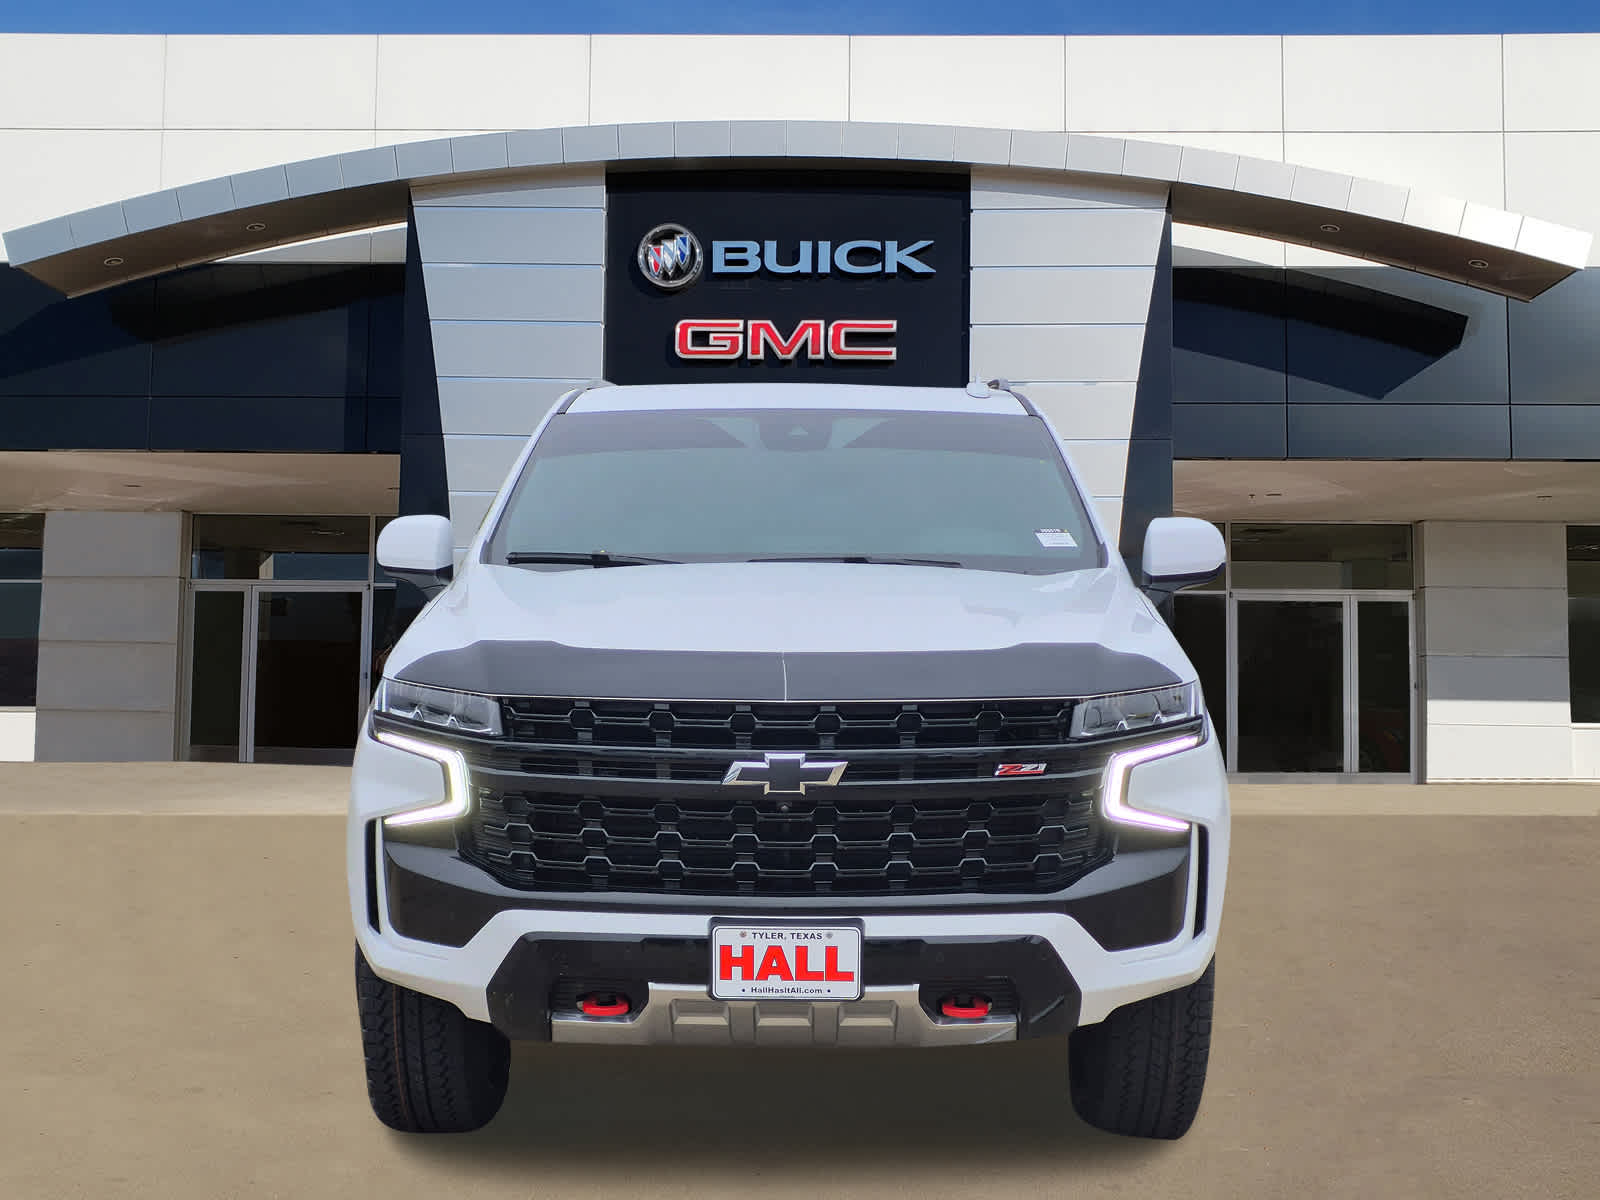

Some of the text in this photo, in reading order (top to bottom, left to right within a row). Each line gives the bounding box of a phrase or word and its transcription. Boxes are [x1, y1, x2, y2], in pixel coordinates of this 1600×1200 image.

[711, 240, 936, 273] BUICK
[675, 319, 897, 360] GMC
[751, 932, 823, 941] TYLER, TEXAS
[719, 944, 855, 982] HALL
